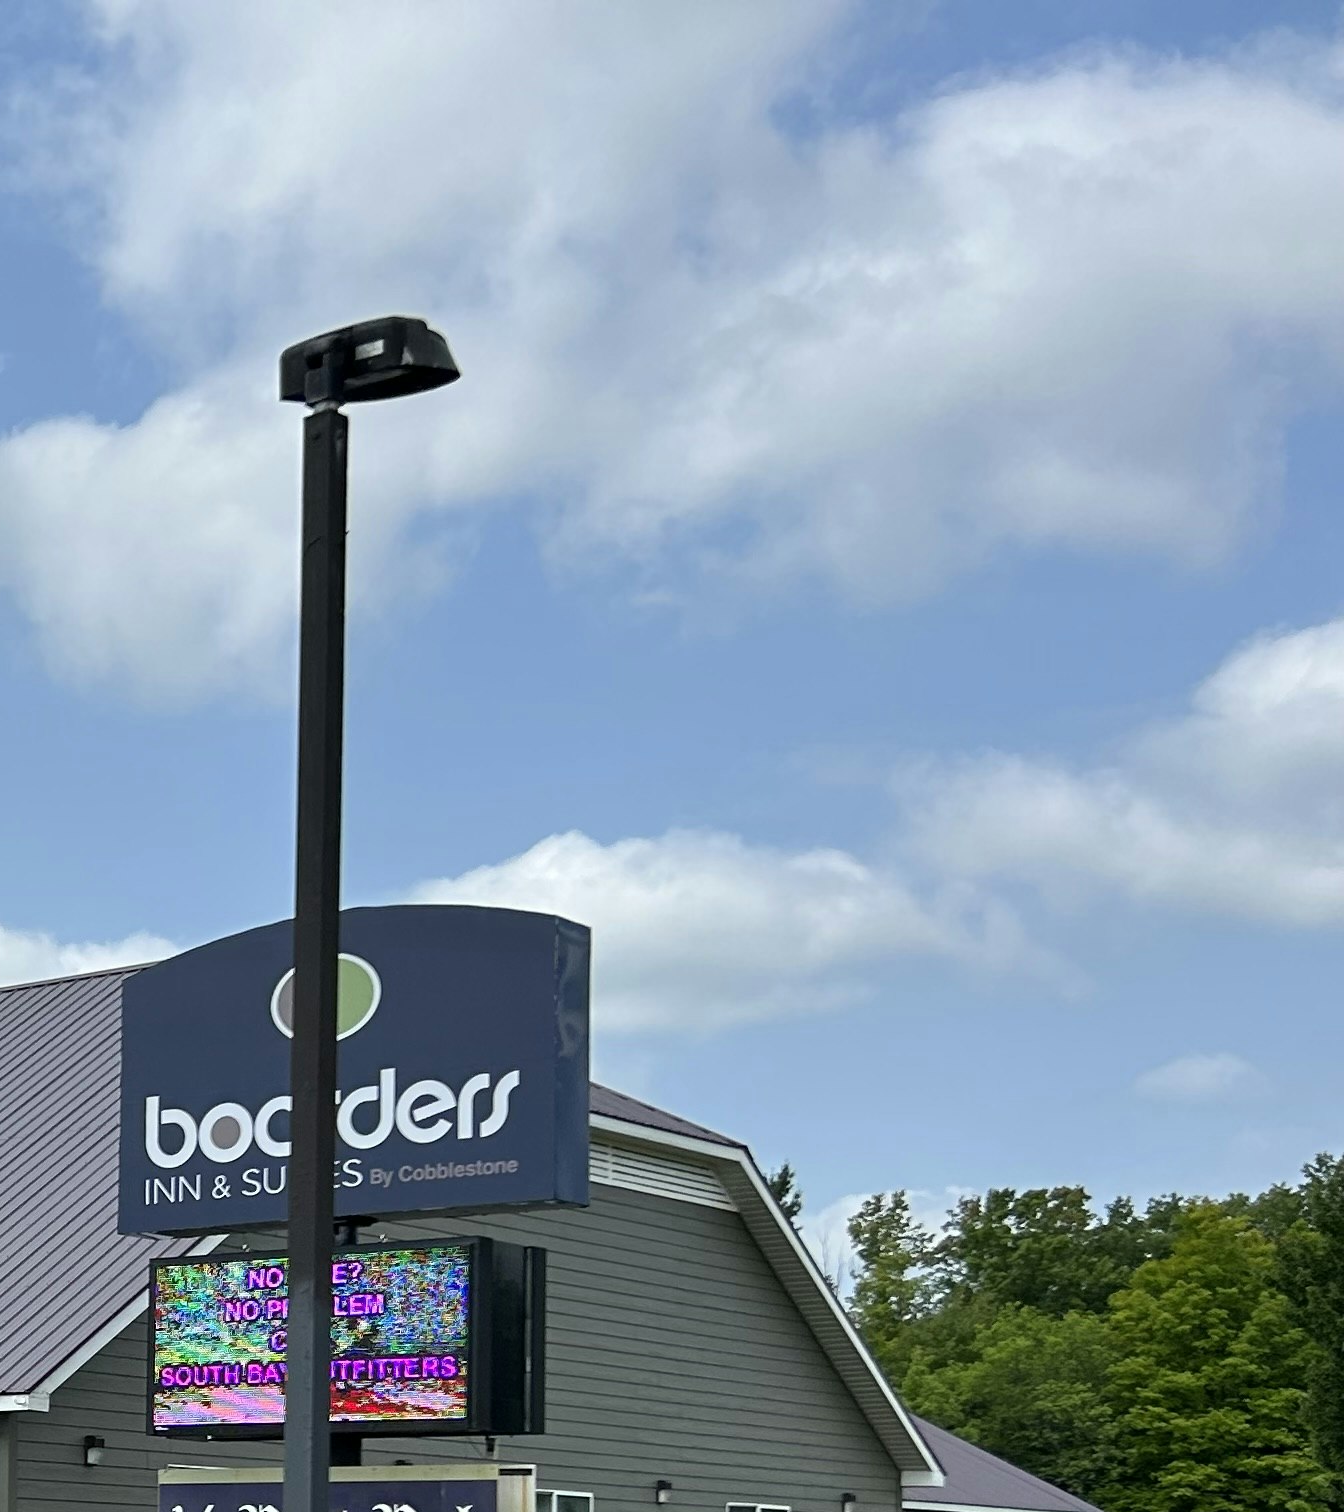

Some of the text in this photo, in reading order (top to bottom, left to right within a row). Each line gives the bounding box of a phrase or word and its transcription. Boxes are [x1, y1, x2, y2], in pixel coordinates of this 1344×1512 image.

[145, 1067, 520, 1169] boaders
[144, 1174, 201, 1206] INN
[211, 1175, 232, 1200] &
[369, 1167, 393, 1188] By
[398, 1158, 520, 1184] Cobblestone
[248, 1267, 284, 1290] NO
[225, 1301, 261, 1322] NO
[160, 1363, 241, 1387] SOUTH
